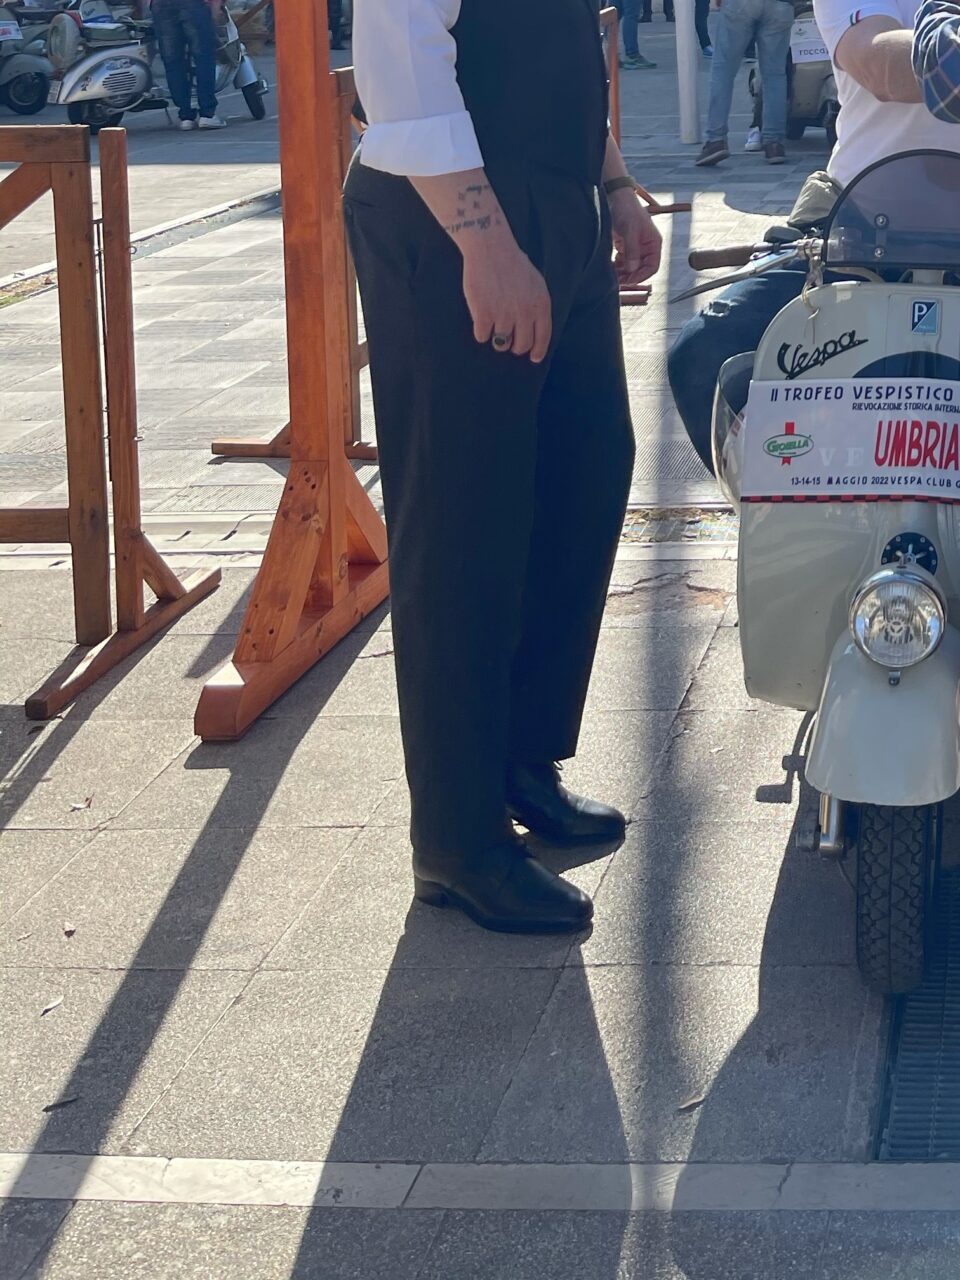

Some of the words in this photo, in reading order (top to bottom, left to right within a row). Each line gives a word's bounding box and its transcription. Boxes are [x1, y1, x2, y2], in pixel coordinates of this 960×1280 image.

[777, 330, 868, 380] Vespa
[770, 388, 779, 402] II
[784, 386, 844, 401] TROFEO
[852, 386, 954, 402] VESPISTICO
[852, 402, 902, 411] RIEVOCAZIONE
[904, 402, 933, 412] STORICA
[874, 420, 959, 471] UMBRIA
[791, 476, 821, 486] 13-14-15
[827, 476, 868, 485] MAGGIO
[871, 476, 889, 485] 2022
[890, 476, 922, 486] VESPA
[926, 477, 952, 488] CLUB
